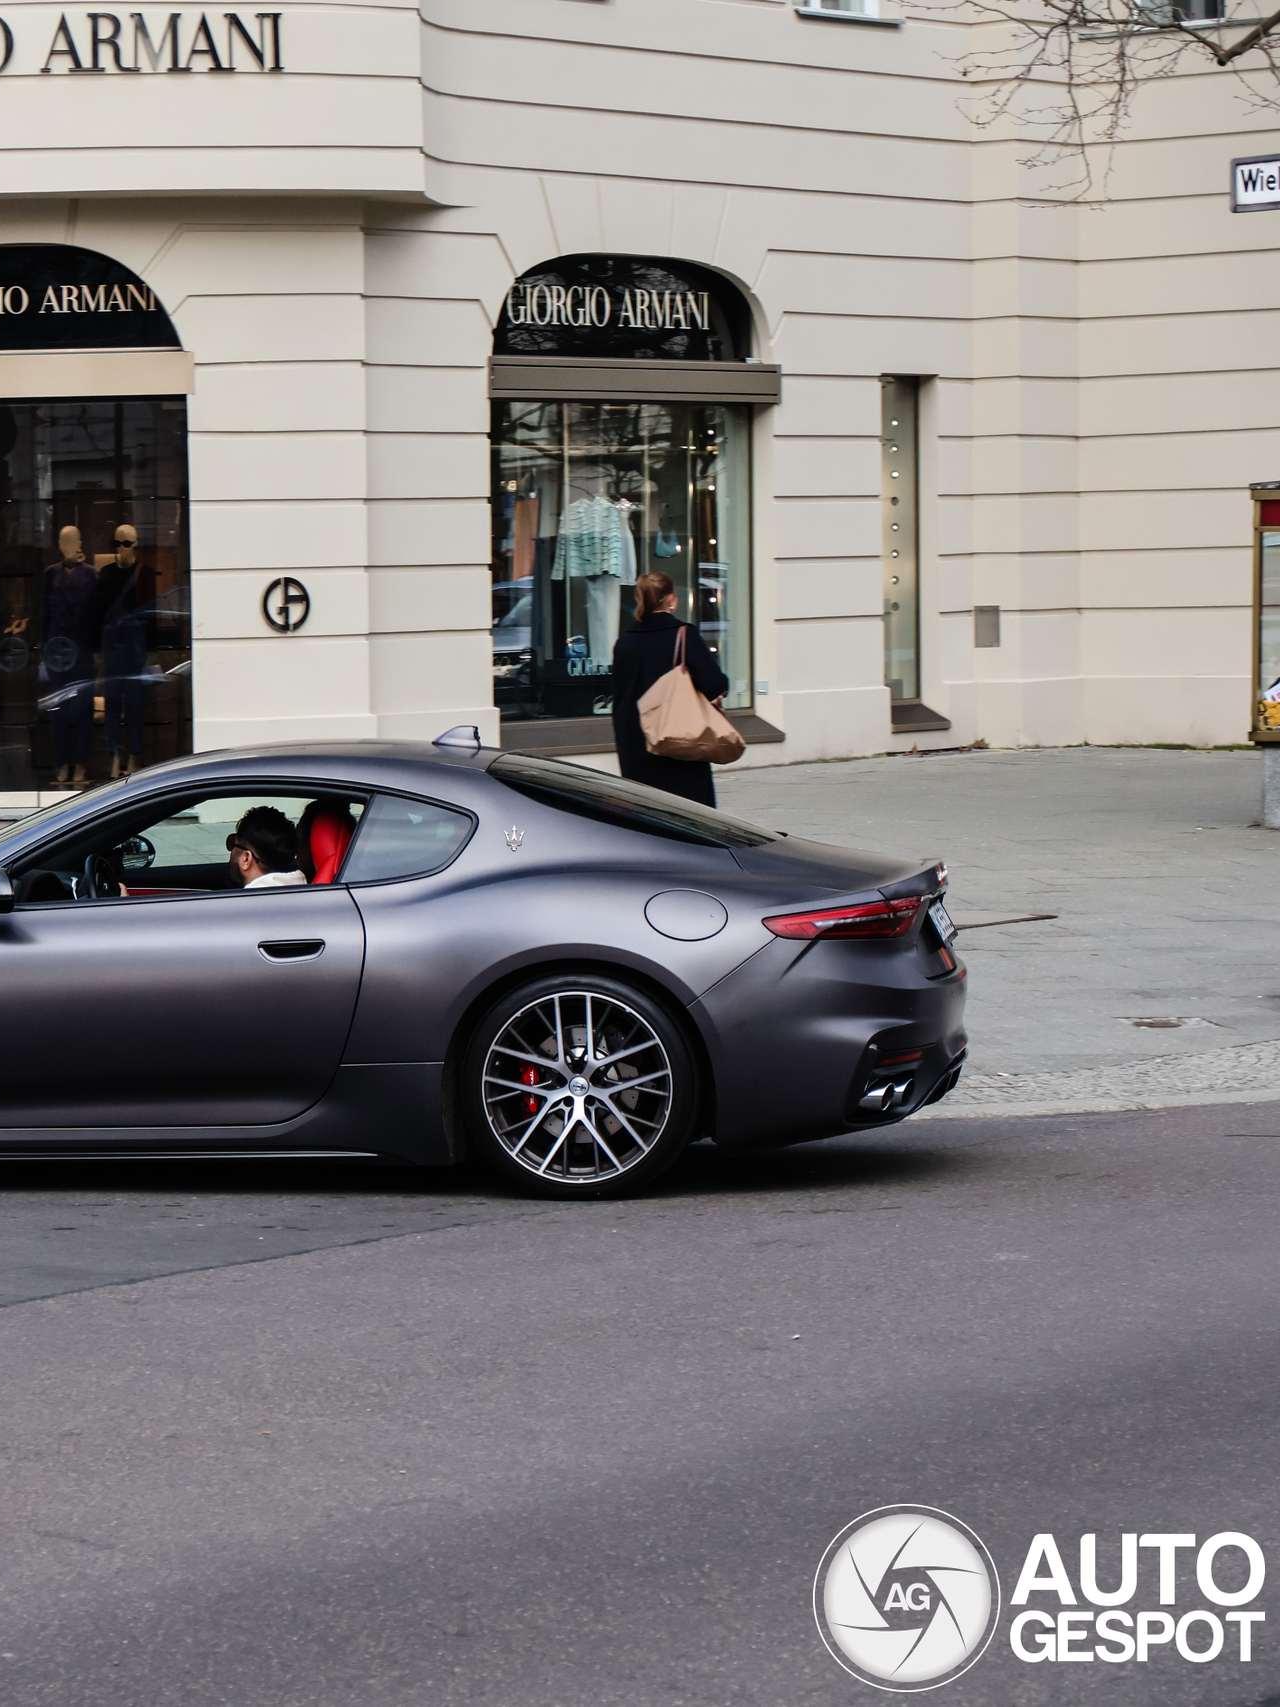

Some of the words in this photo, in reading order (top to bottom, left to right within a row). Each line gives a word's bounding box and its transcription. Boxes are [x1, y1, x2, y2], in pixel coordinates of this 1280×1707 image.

[40, 12, 284, 73] ARMANI
[38, 283, 158, 314] ARMANI
[506, 284, 612, 327] GIORGIO
[617, 288, 710, 330] ARMANI
